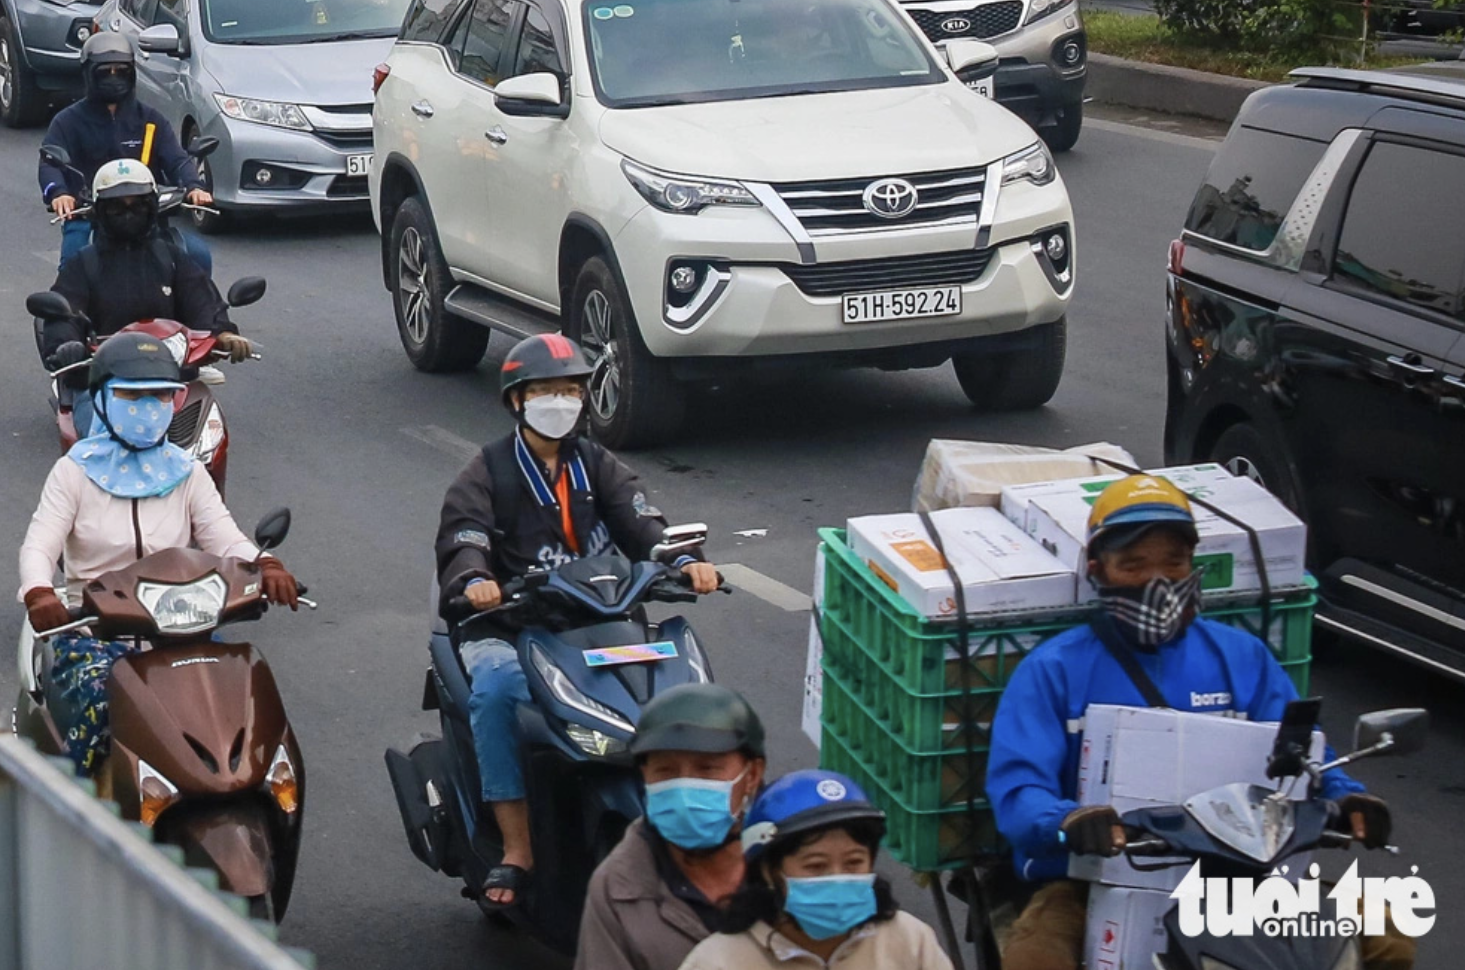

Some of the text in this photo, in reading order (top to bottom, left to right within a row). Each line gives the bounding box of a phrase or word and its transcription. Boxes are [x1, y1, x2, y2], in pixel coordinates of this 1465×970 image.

[946, 21, 966, 30] KIA
[847, 289, 957, 320] 51H-592.24
[171, 656, 220, 668] HONDA
